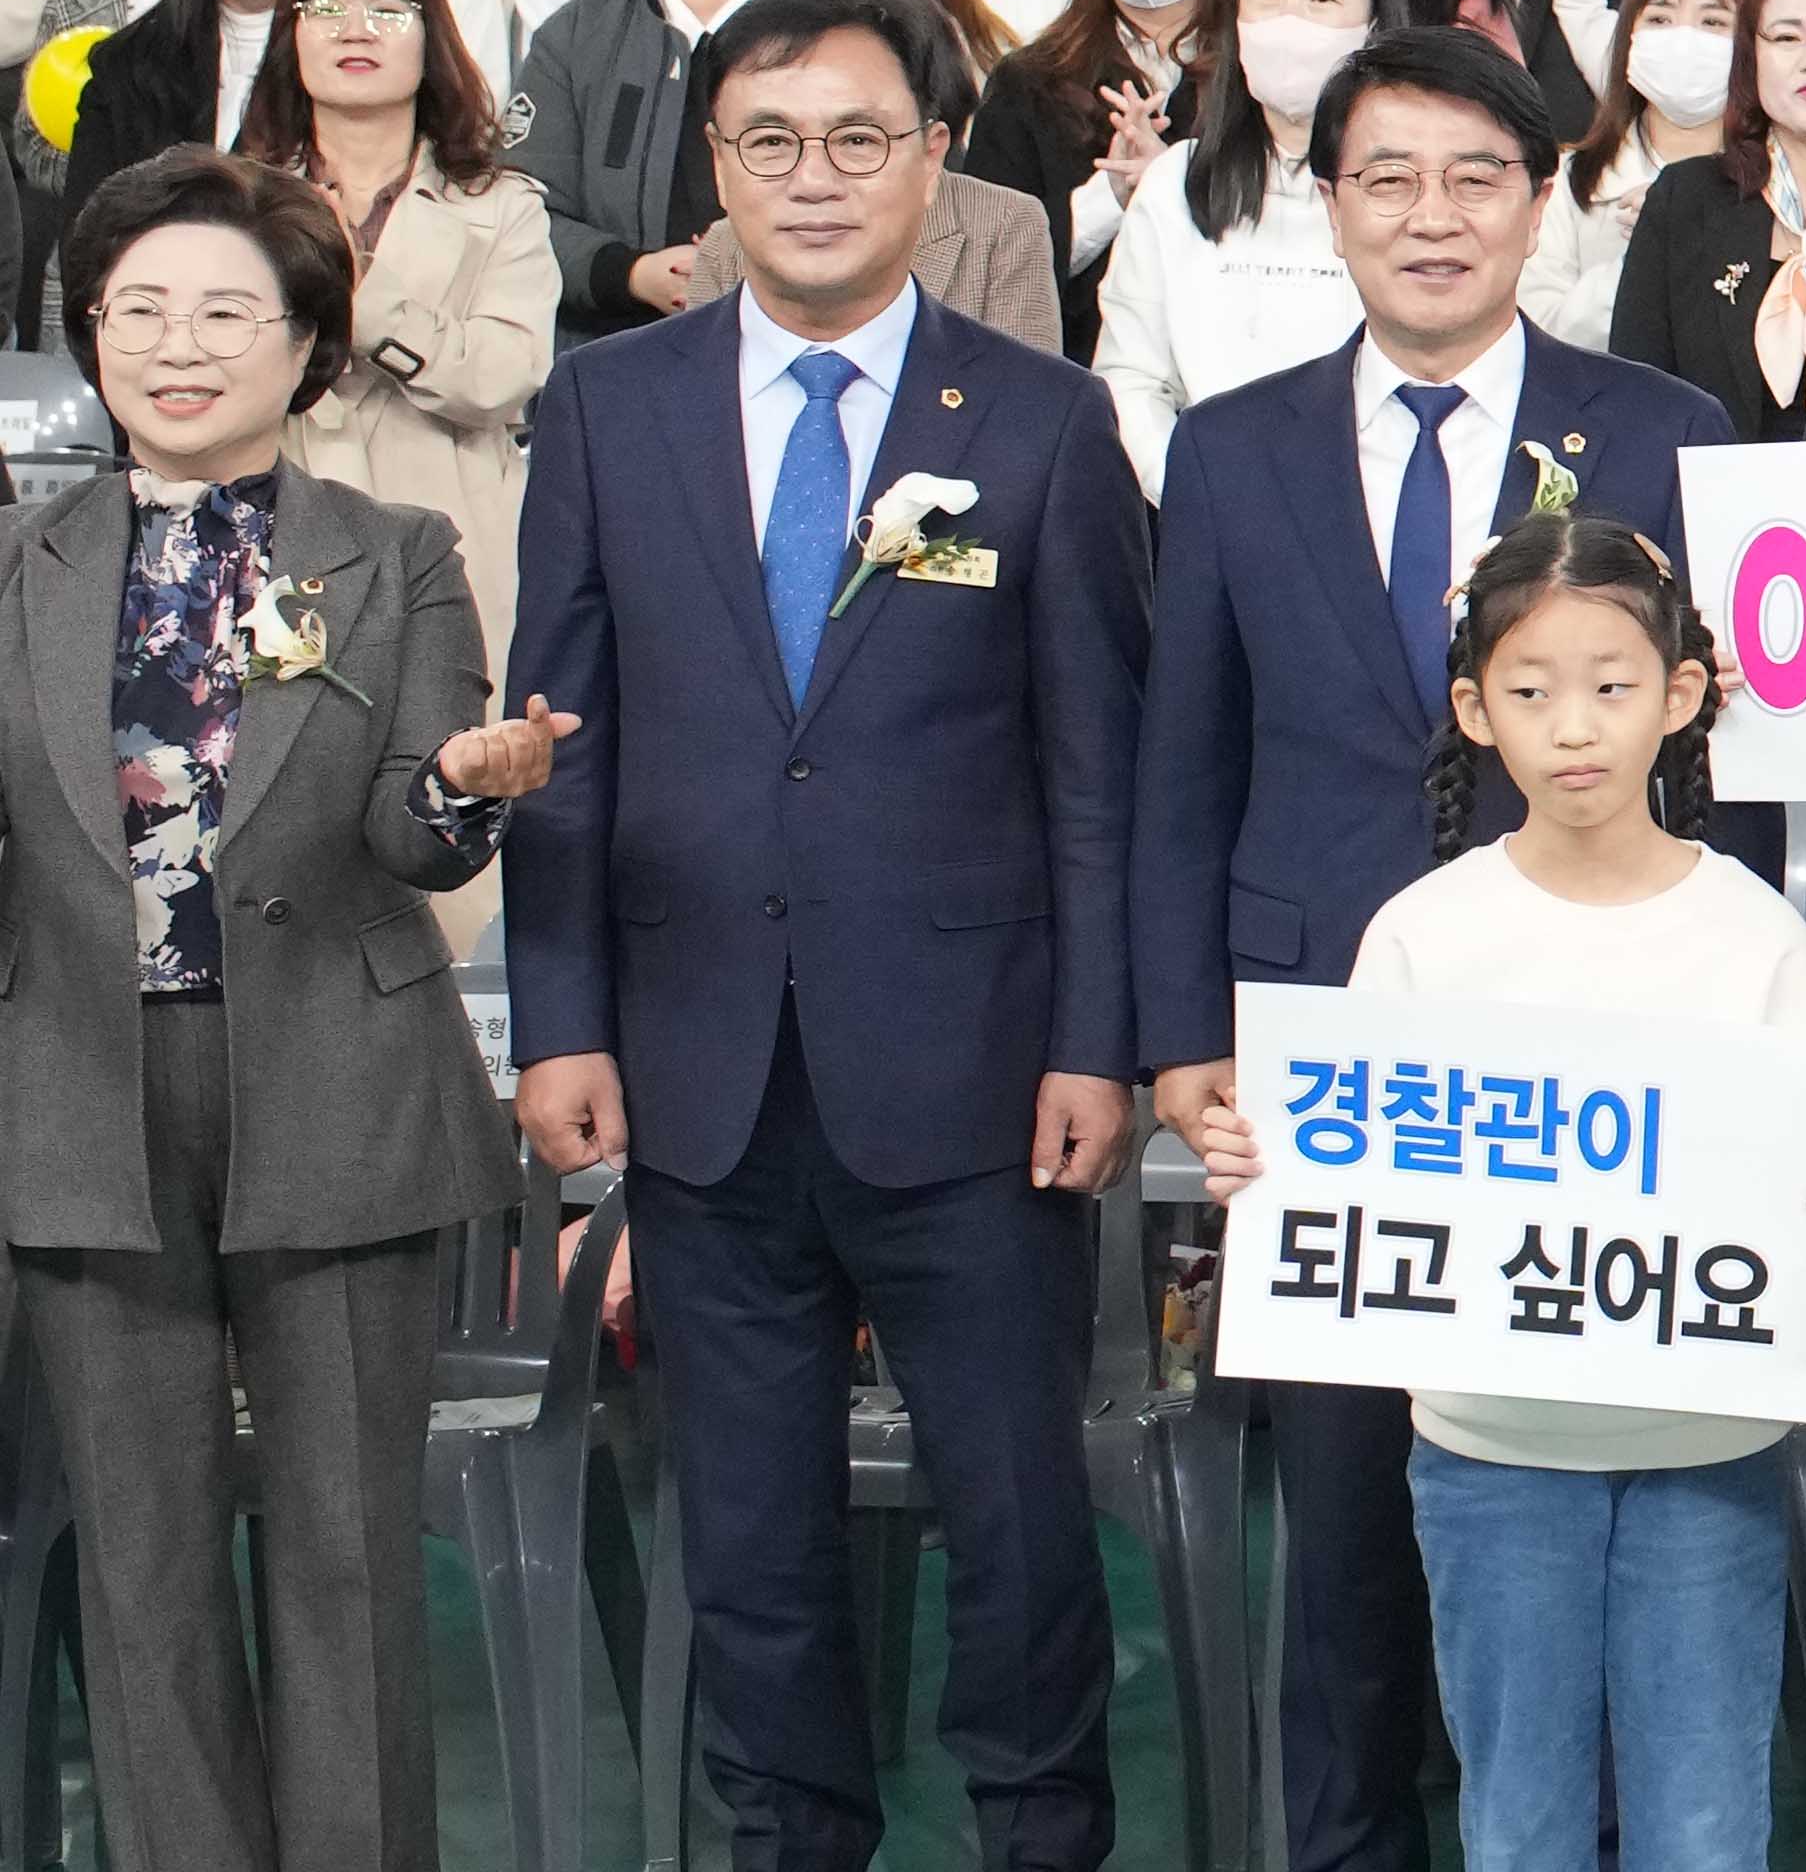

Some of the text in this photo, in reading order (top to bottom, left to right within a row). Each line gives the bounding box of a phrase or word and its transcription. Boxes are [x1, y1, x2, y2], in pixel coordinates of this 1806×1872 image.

[1286, 1058, 1662, 1198] 경찰관이
[1271, 1206, 1775, 1346] 되고 싶어요
